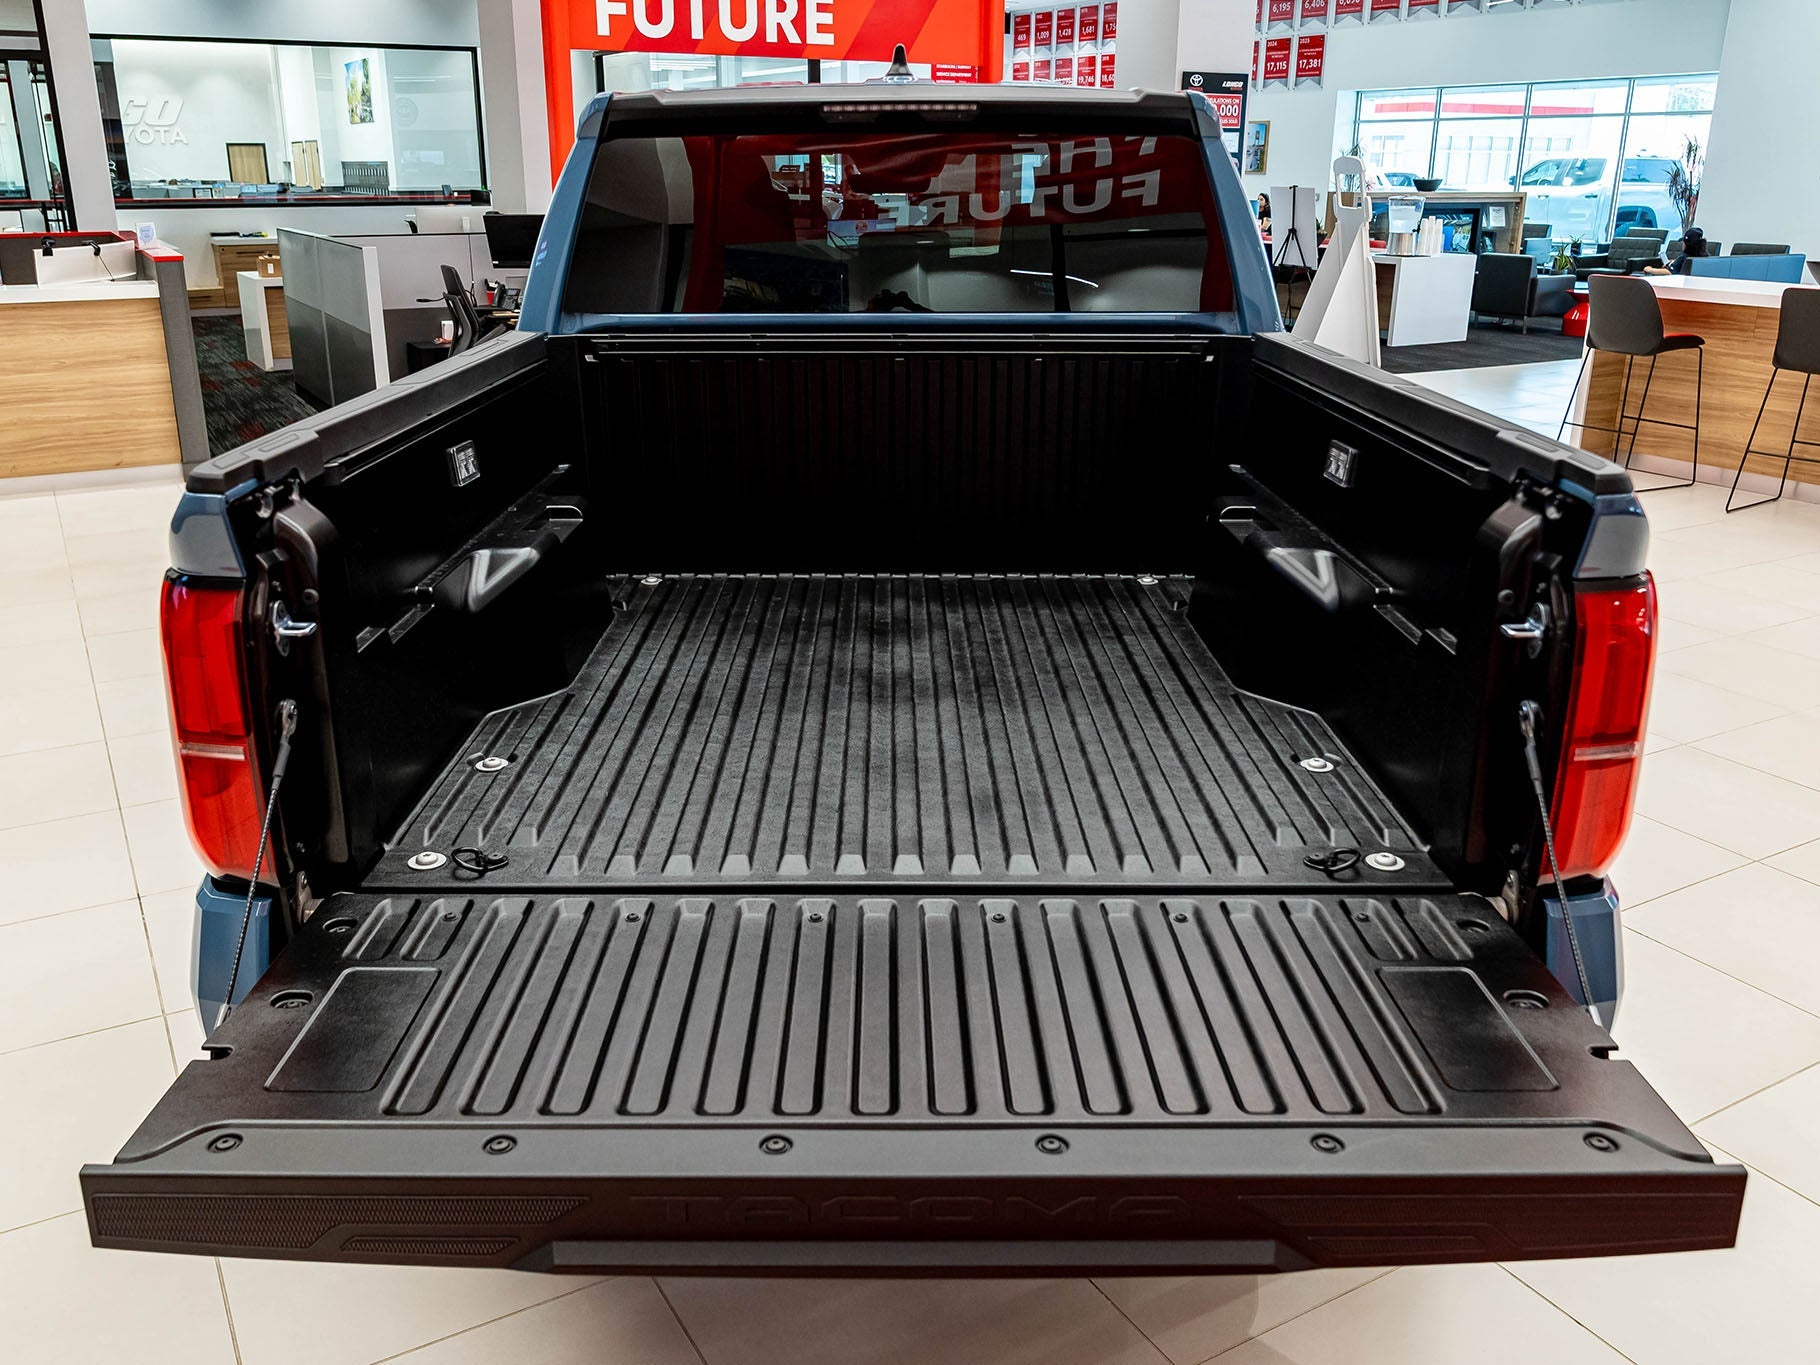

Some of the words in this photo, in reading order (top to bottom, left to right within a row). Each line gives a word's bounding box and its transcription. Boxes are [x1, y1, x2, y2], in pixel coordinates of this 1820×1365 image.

[1272, 2, 1291, 13] 6,195
[595, 0, 836, 46] FUTURE
[1266, 61, 1287, 72] 17,115
[1299, 58, 1321, 69] 17,381
[627, 1195, 1194, 1225] TACOMA
